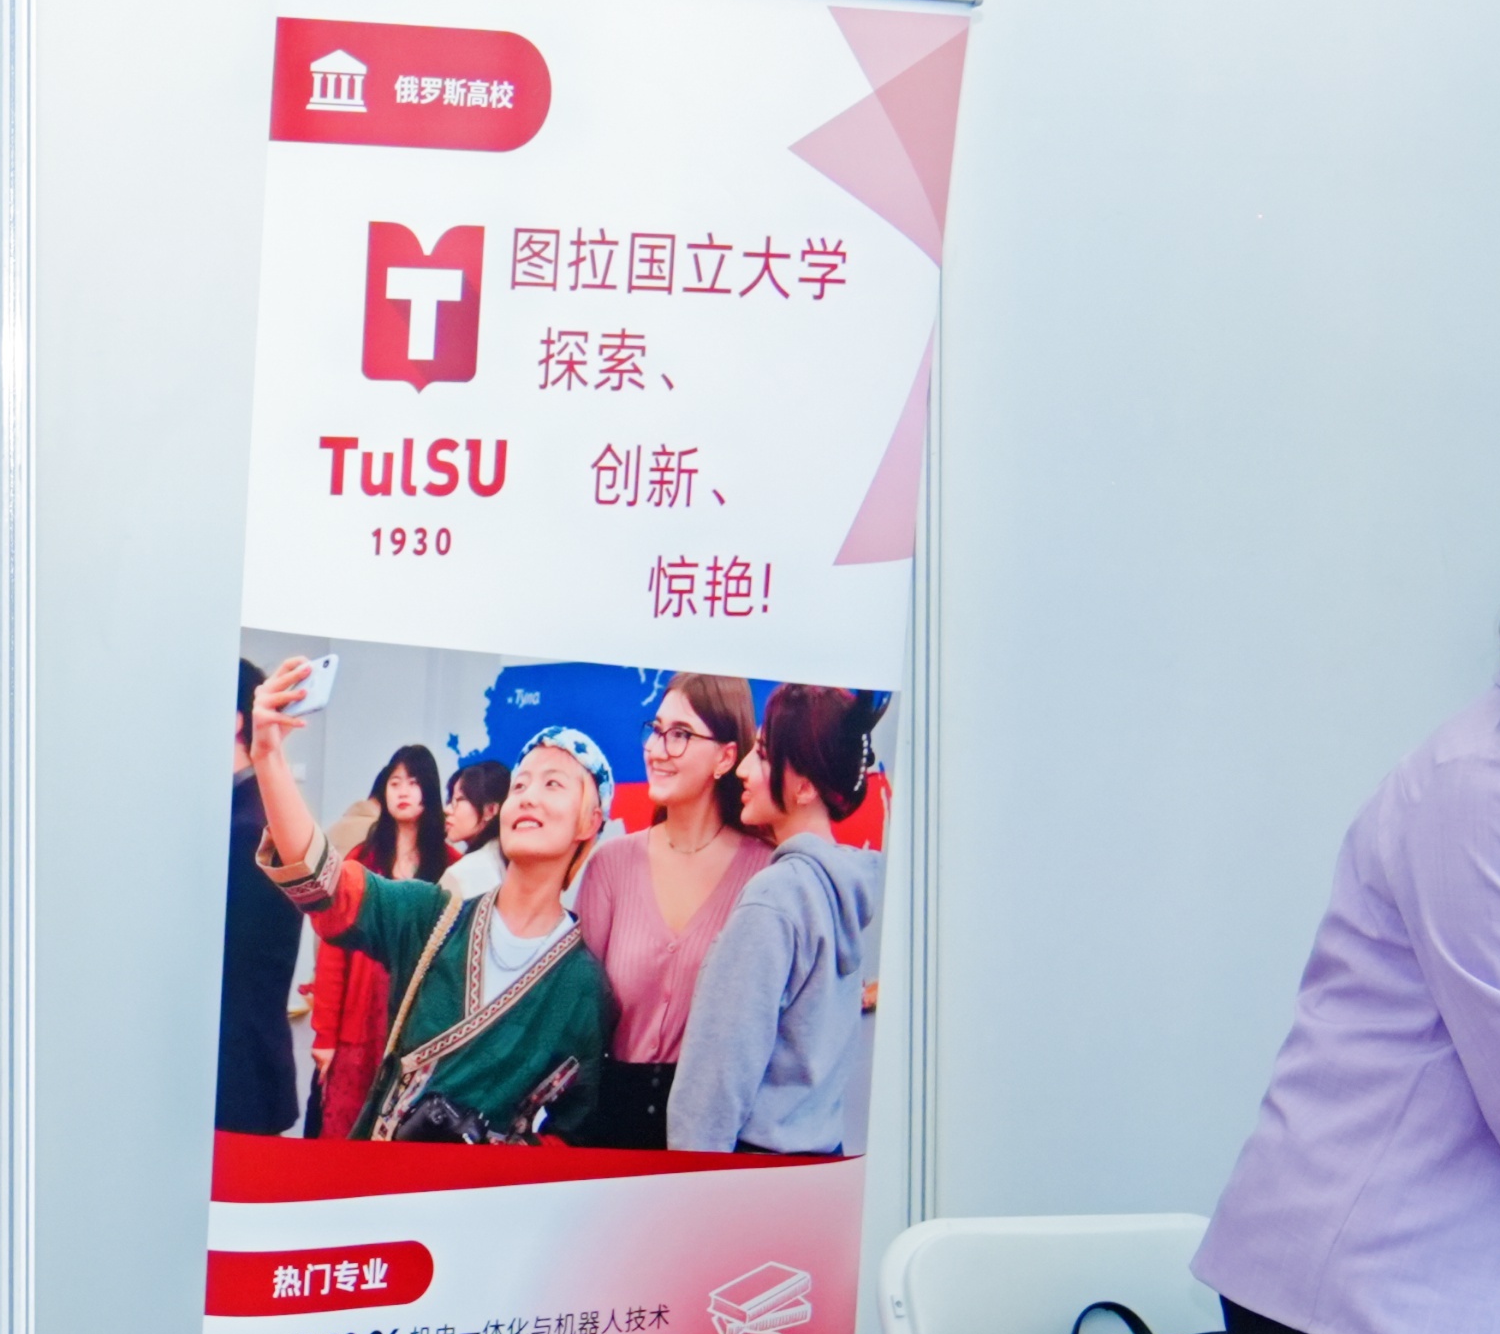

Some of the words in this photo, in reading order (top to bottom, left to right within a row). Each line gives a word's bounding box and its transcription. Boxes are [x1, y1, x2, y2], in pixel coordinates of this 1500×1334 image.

[394, 76, 514, 108] 俄罗斯高校
[510, 228, 848, 302] 图拉国立大学
[538, 328, 676, 393] 探索、
[319, 436, 507, 498] TulSU
[590, 443, 728, 509] 创新、
[371, 527, 452, 557] 1930
[272, 1258, 388, 1299] 热门专业
